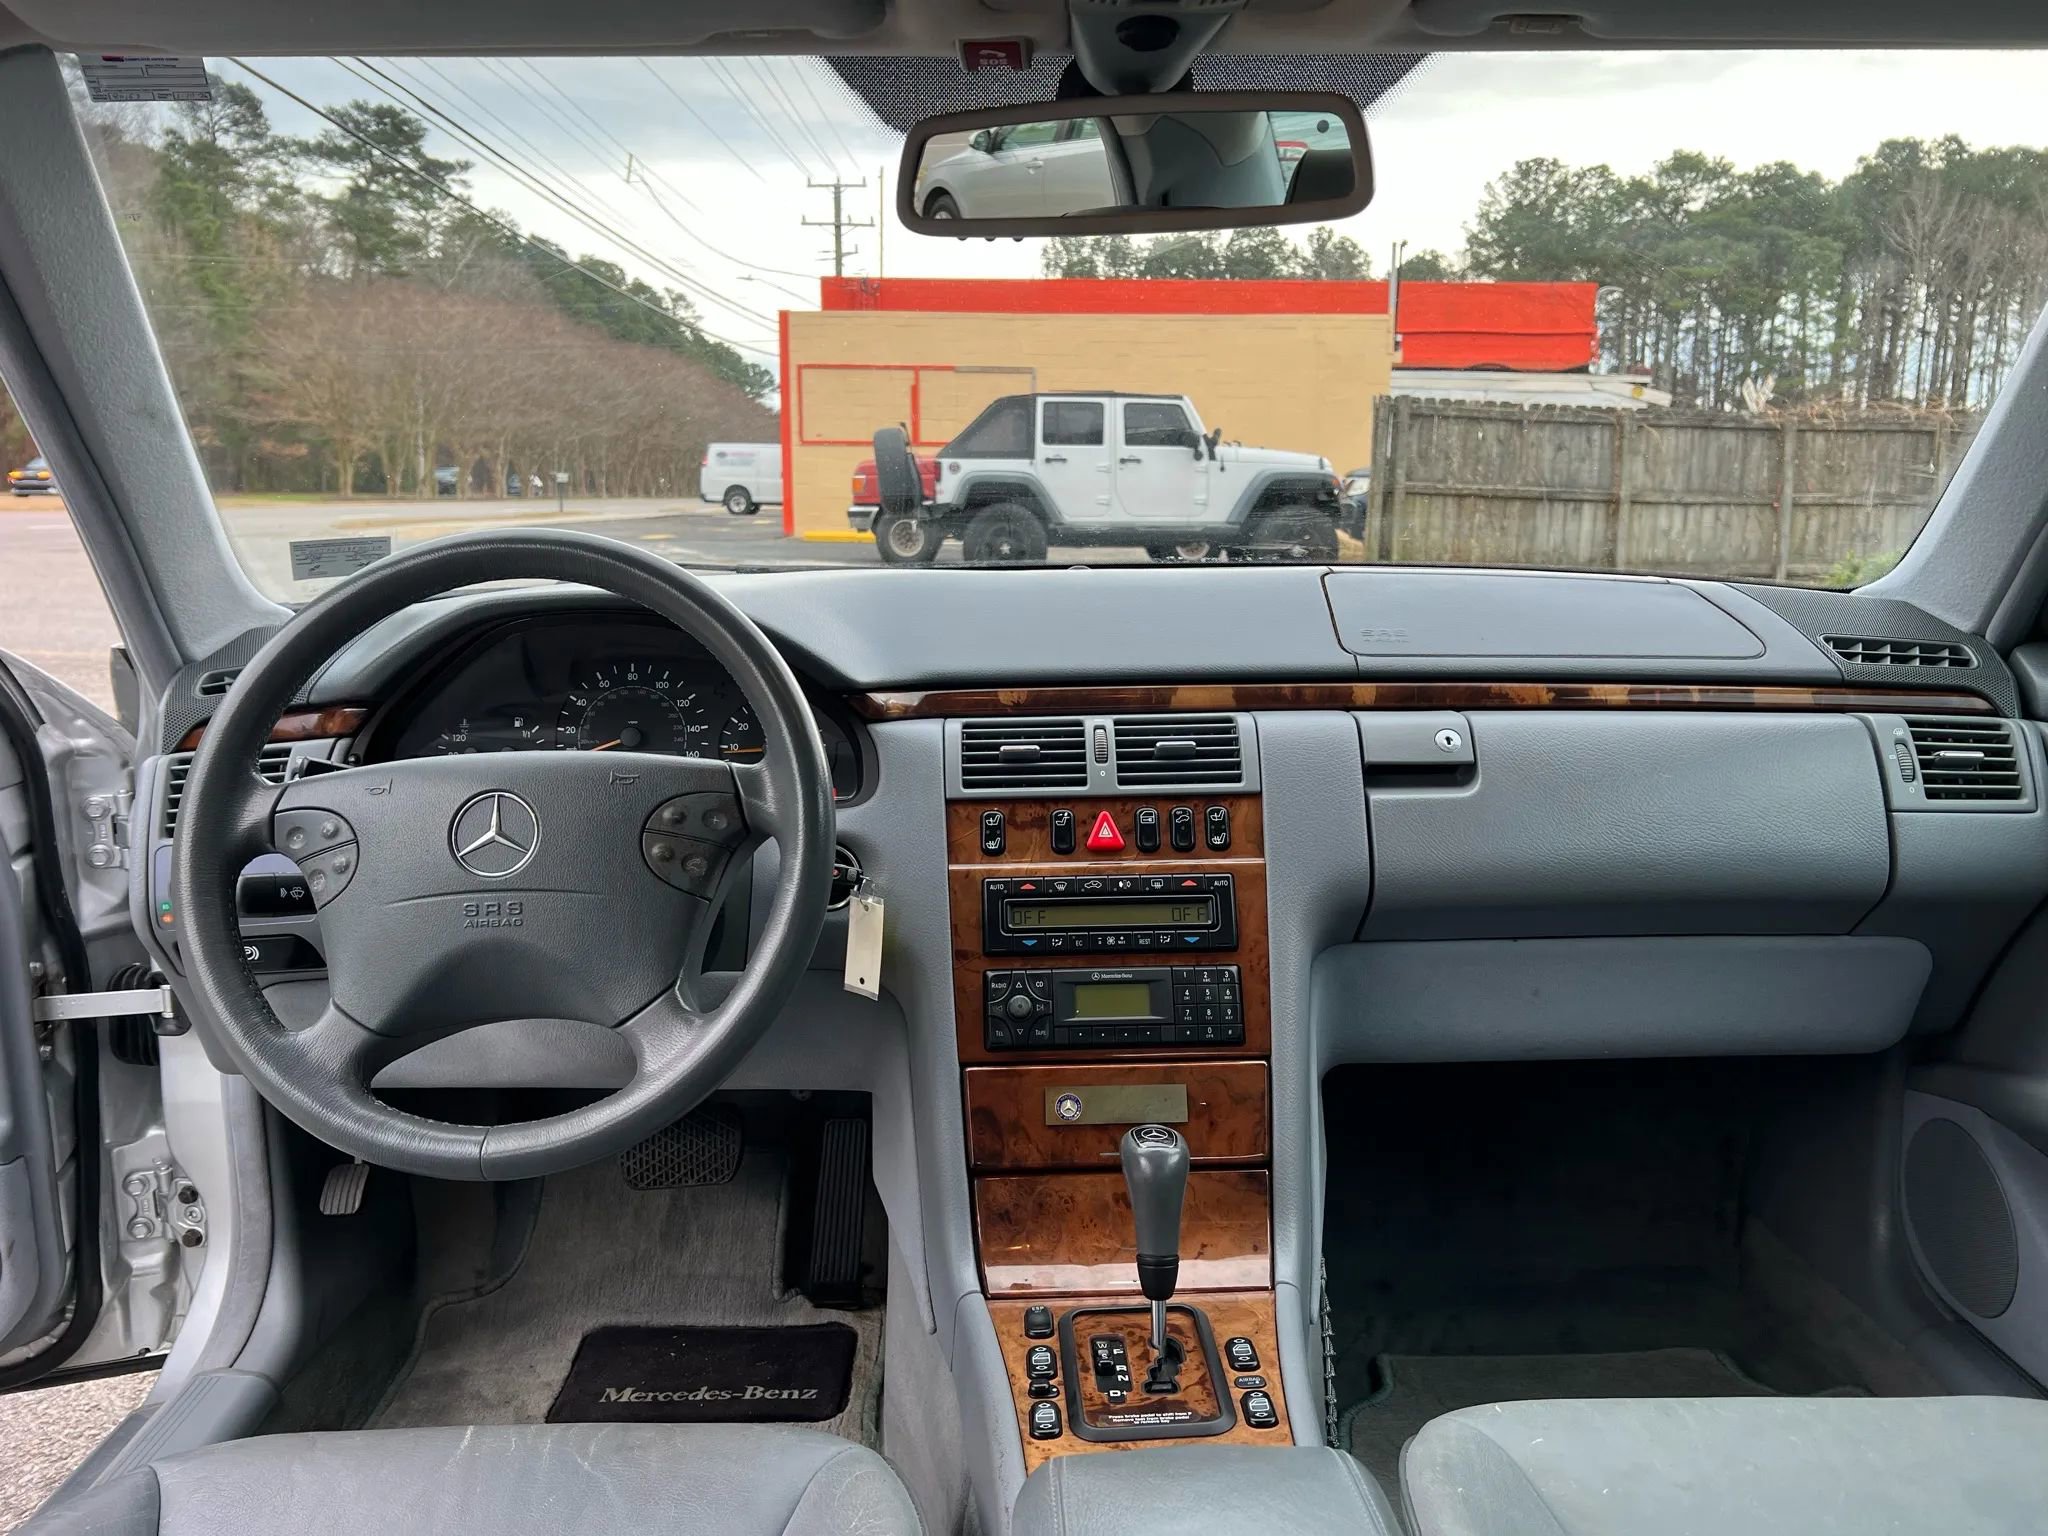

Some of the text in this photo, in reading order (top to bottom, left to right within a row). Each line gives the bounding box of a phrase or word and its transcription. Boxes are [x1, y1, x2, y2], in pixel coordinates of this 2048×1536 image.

[464, 901, 523, 917] SRS
[1172, 907, 1205, 921] OFF
[464, 918, 524, 928] AIRBAG
[1013, 910, 1046, 924] OFF
[599, 1385, 818, 1402] Mercedes-Benz
